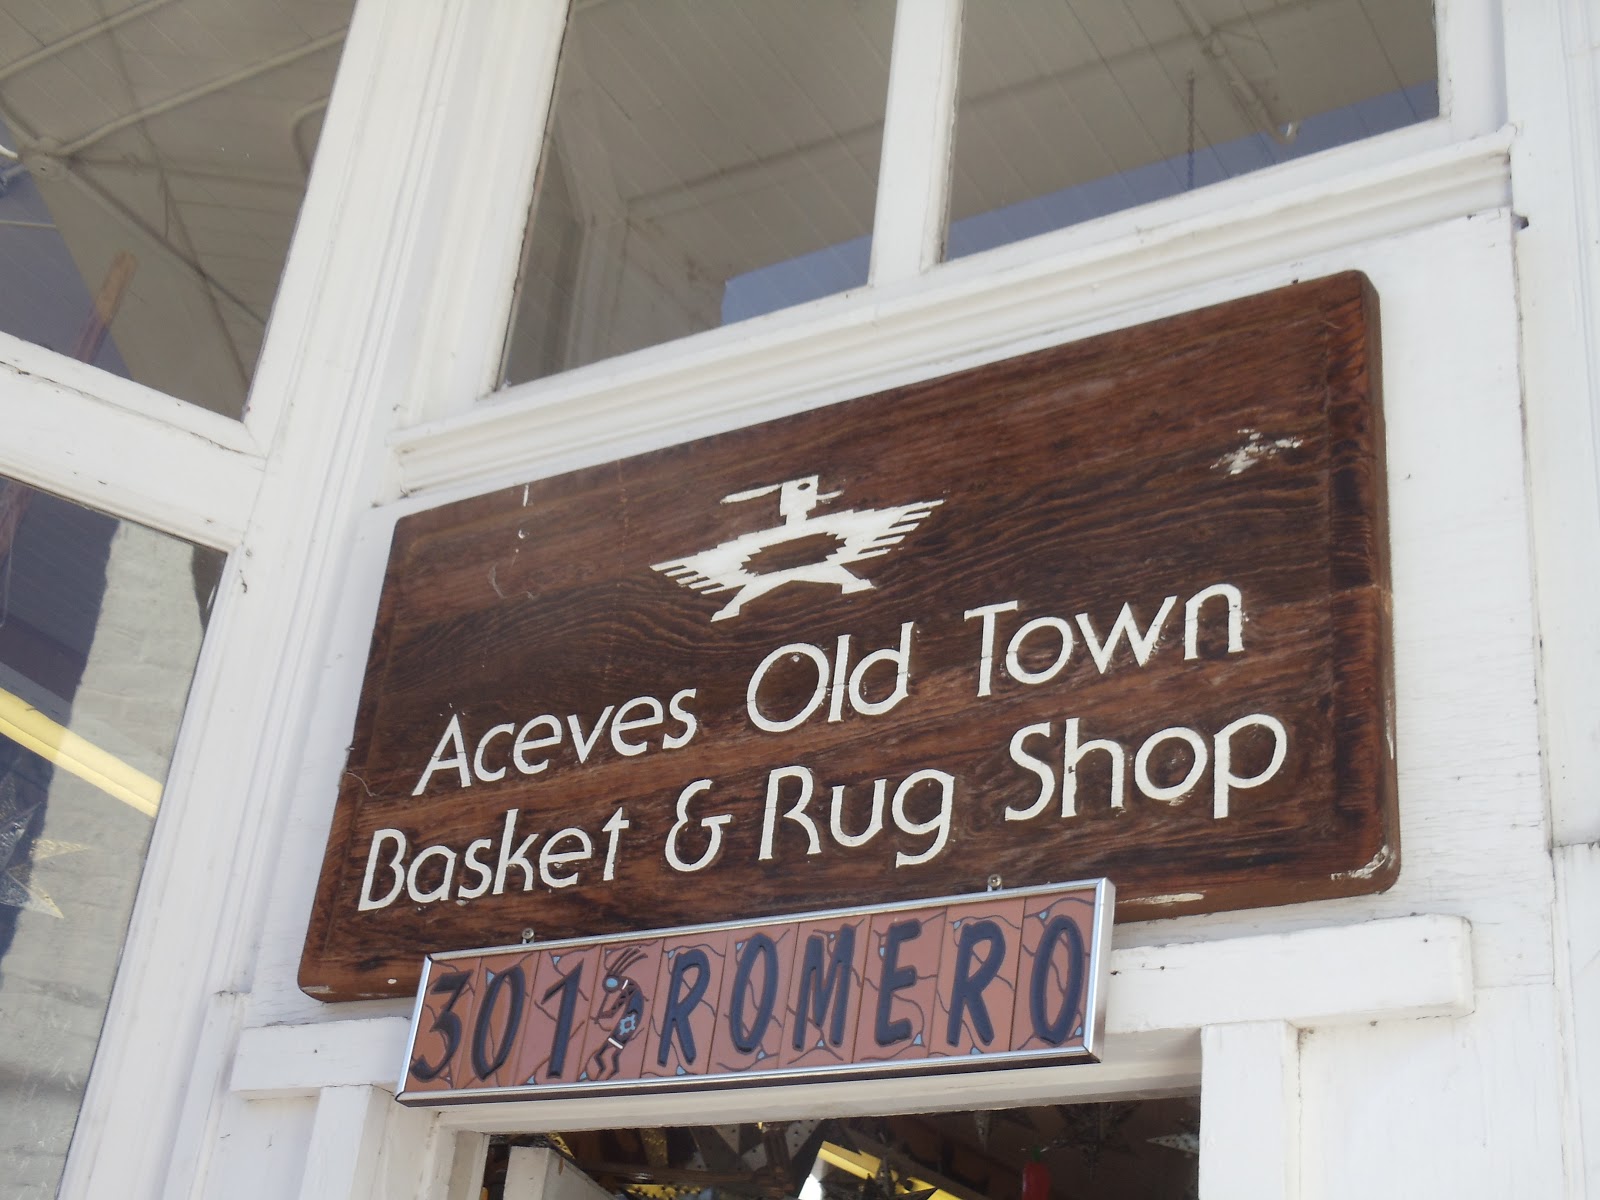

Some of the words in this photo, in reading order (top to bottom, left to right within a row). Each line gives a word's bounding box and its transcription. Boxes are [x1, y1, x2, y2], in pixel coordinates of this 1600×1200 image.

[412, 689, 698, 796] Aceves
[747, 622, 914, 732] Old
[964, 584, 1245, 697] Town
[358, 807, 630, 912] Basket
[665, 780, 732, 871] &
[759, 766, 955, 868] Rug
[1005, 714, 1287, 821] Shop
[409, 962, 584, 1081] 301
[657, 914, 1085, 1066] ROMERO
